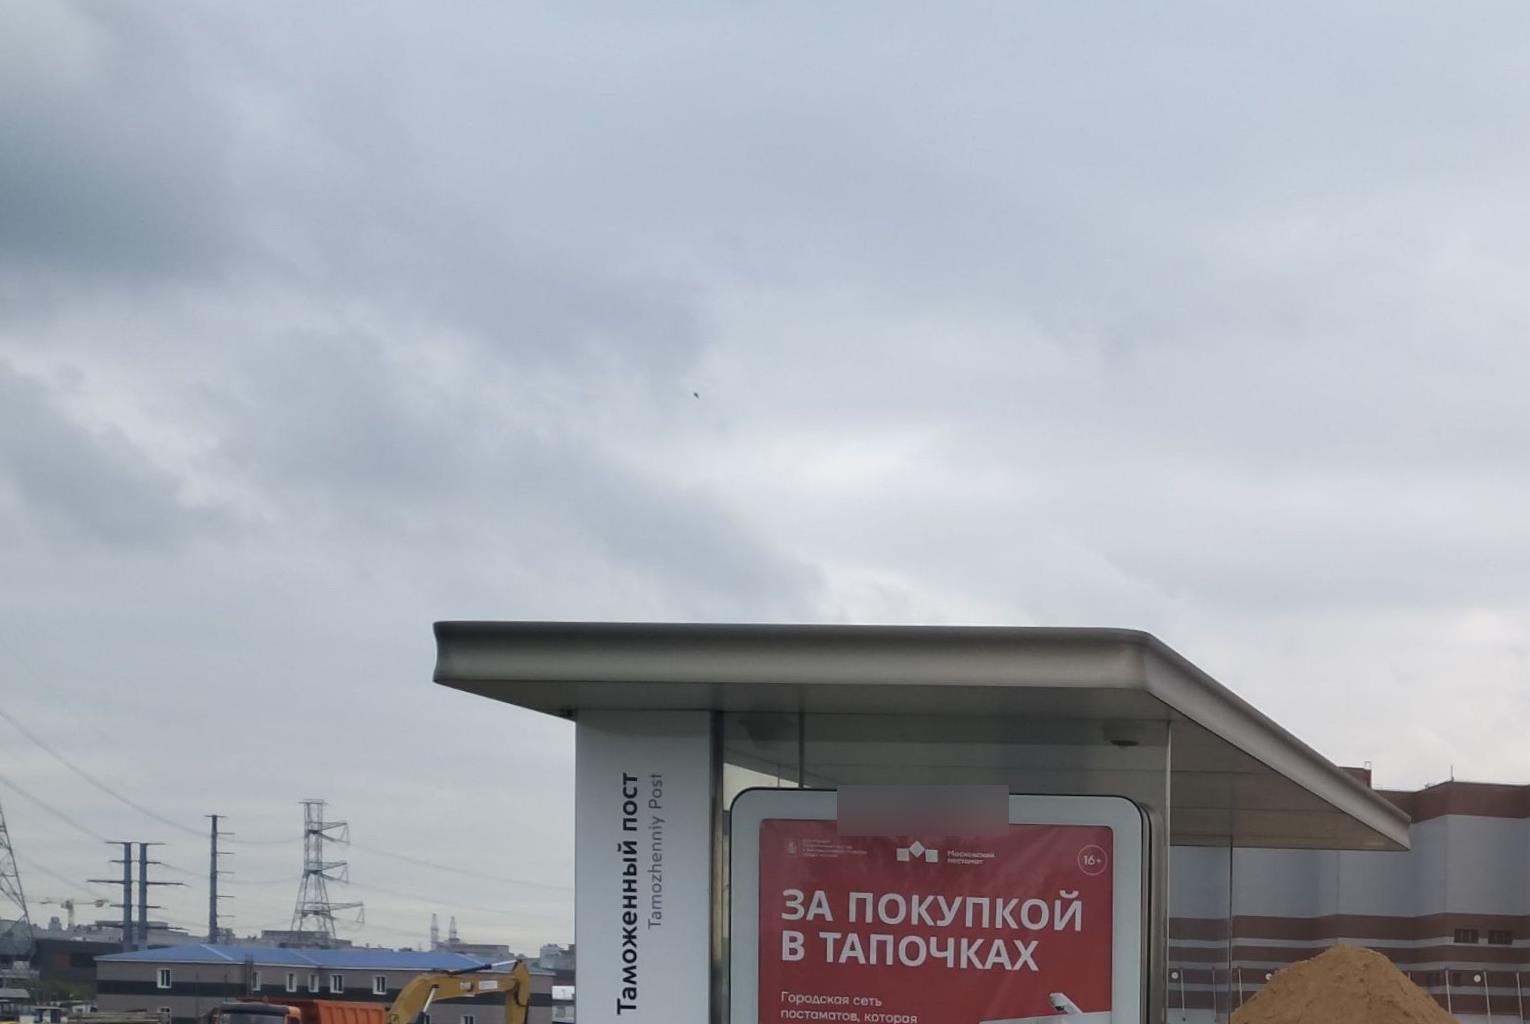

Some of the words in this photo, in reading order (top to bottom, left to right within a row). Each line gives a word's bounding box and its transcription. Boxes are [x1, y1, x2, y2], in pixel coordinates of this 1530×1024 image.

[622, 772, 638, 831] пост
[648, 773, 664, 809] Post
[648, 815, 665, 930] Tamozhenniy
[1083, 854, 1103, 867] 16+
[616, 840, 638, 1016] Таможенный
[781, 888, 833, 922] ЗА
[848, 889, 1082, 932] ПОКУПКОЙ
[781, 929, 806, 962] В
[819, 930, 1040, 972] ТАПОЧКАХ
[780, 991, 850, 1006] Городская
[852, 995, 883, 1007] сеть
[780, 1008, 860, 1023] постаматов,
[864, 1011, 918, 1024] которая
